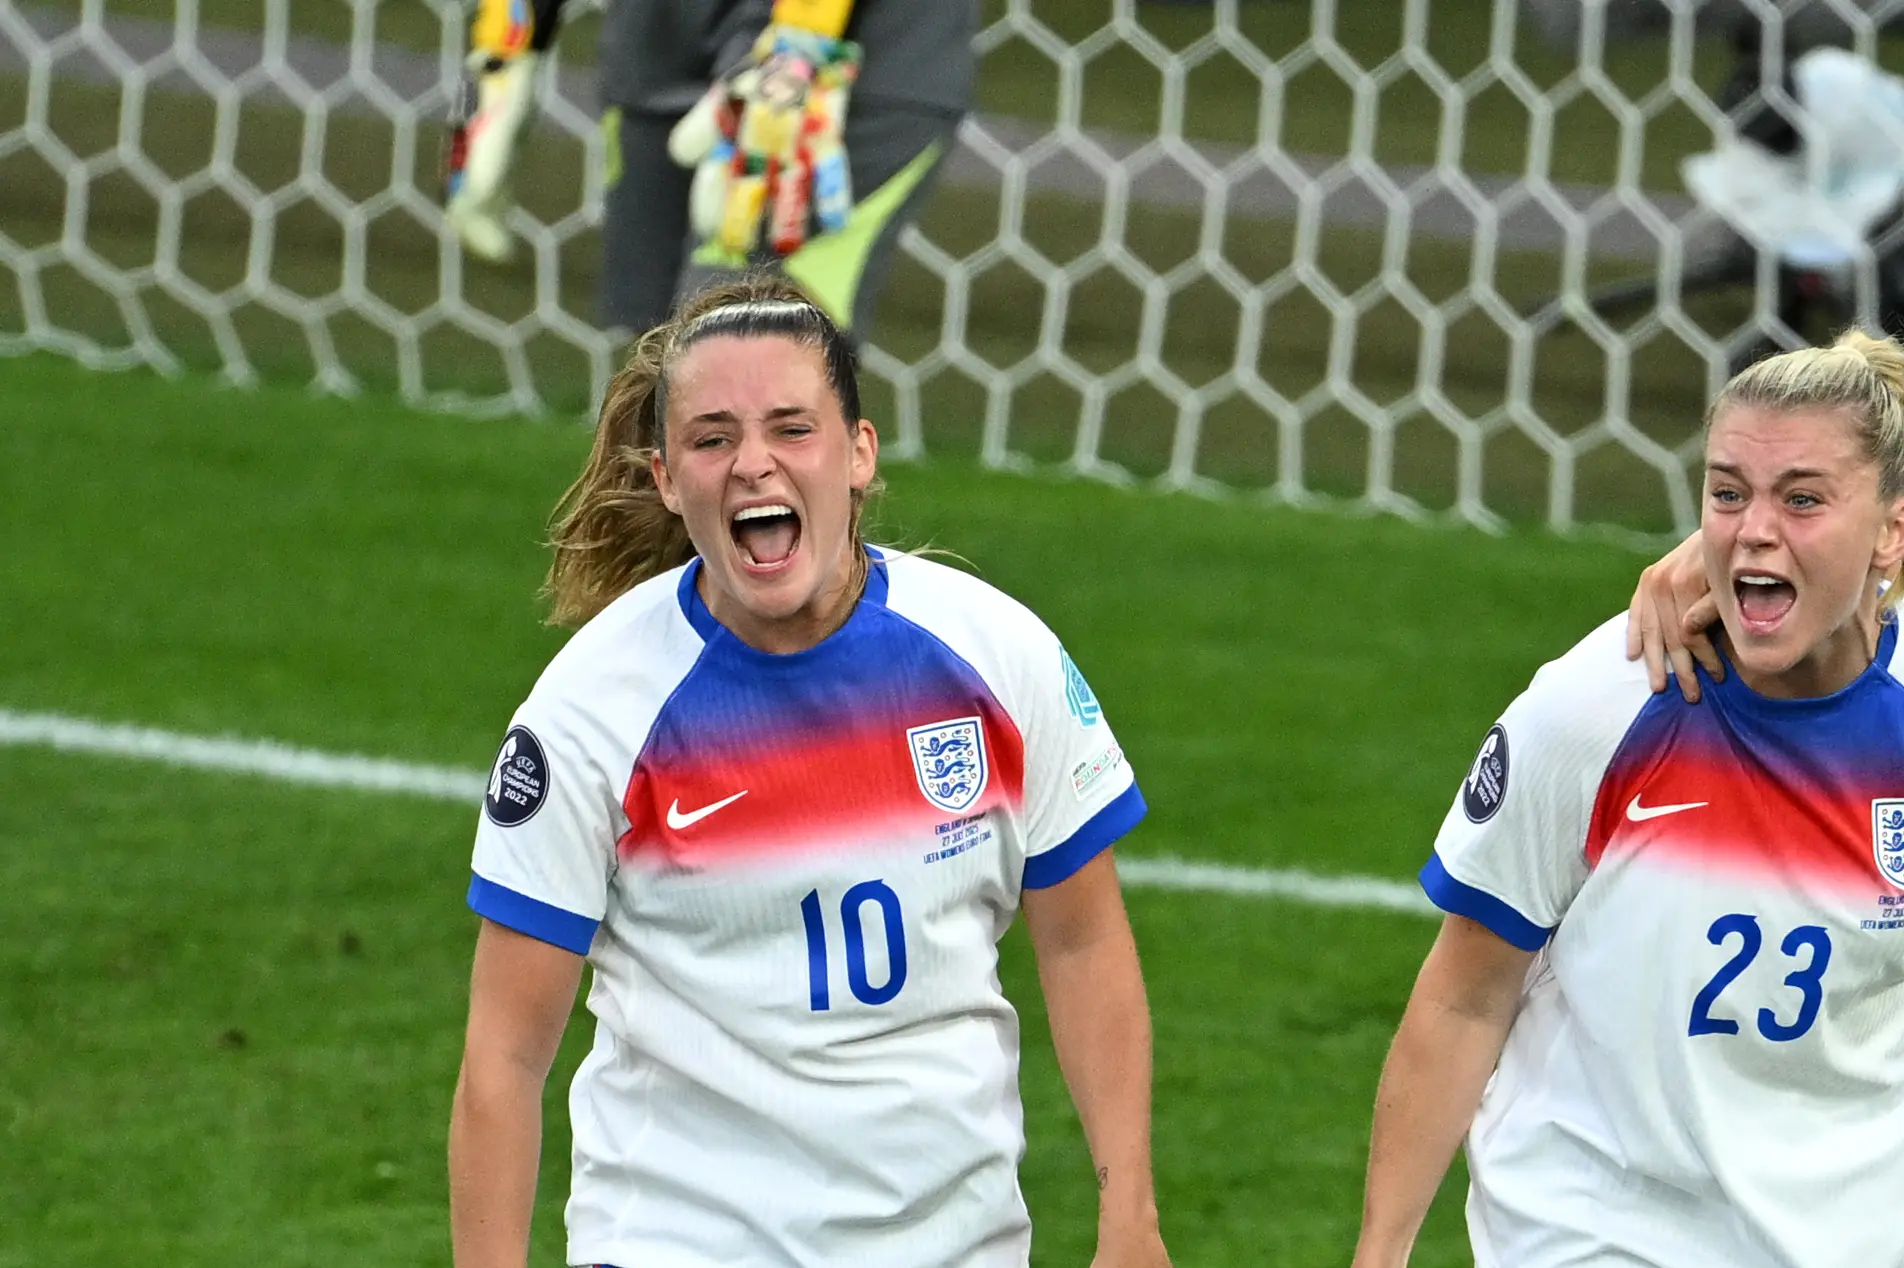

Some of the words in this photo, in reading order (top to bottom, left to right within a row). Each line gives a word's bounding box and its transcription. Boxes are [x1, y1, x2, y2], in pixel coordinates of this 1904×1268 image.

[502, 774, 540, 798] CHAMPIONS
[506, 765, 541, 788] EUROPEAN
[504, 787, 528, 807] 2022
[942, 835, 950, 847] 27
[923, 851, 940, 864] UEFA
[1882, 908, 1892, 918] 27
[800, 879, 907, 1011] 10
[1688, 913, 1832, 1042] 23
